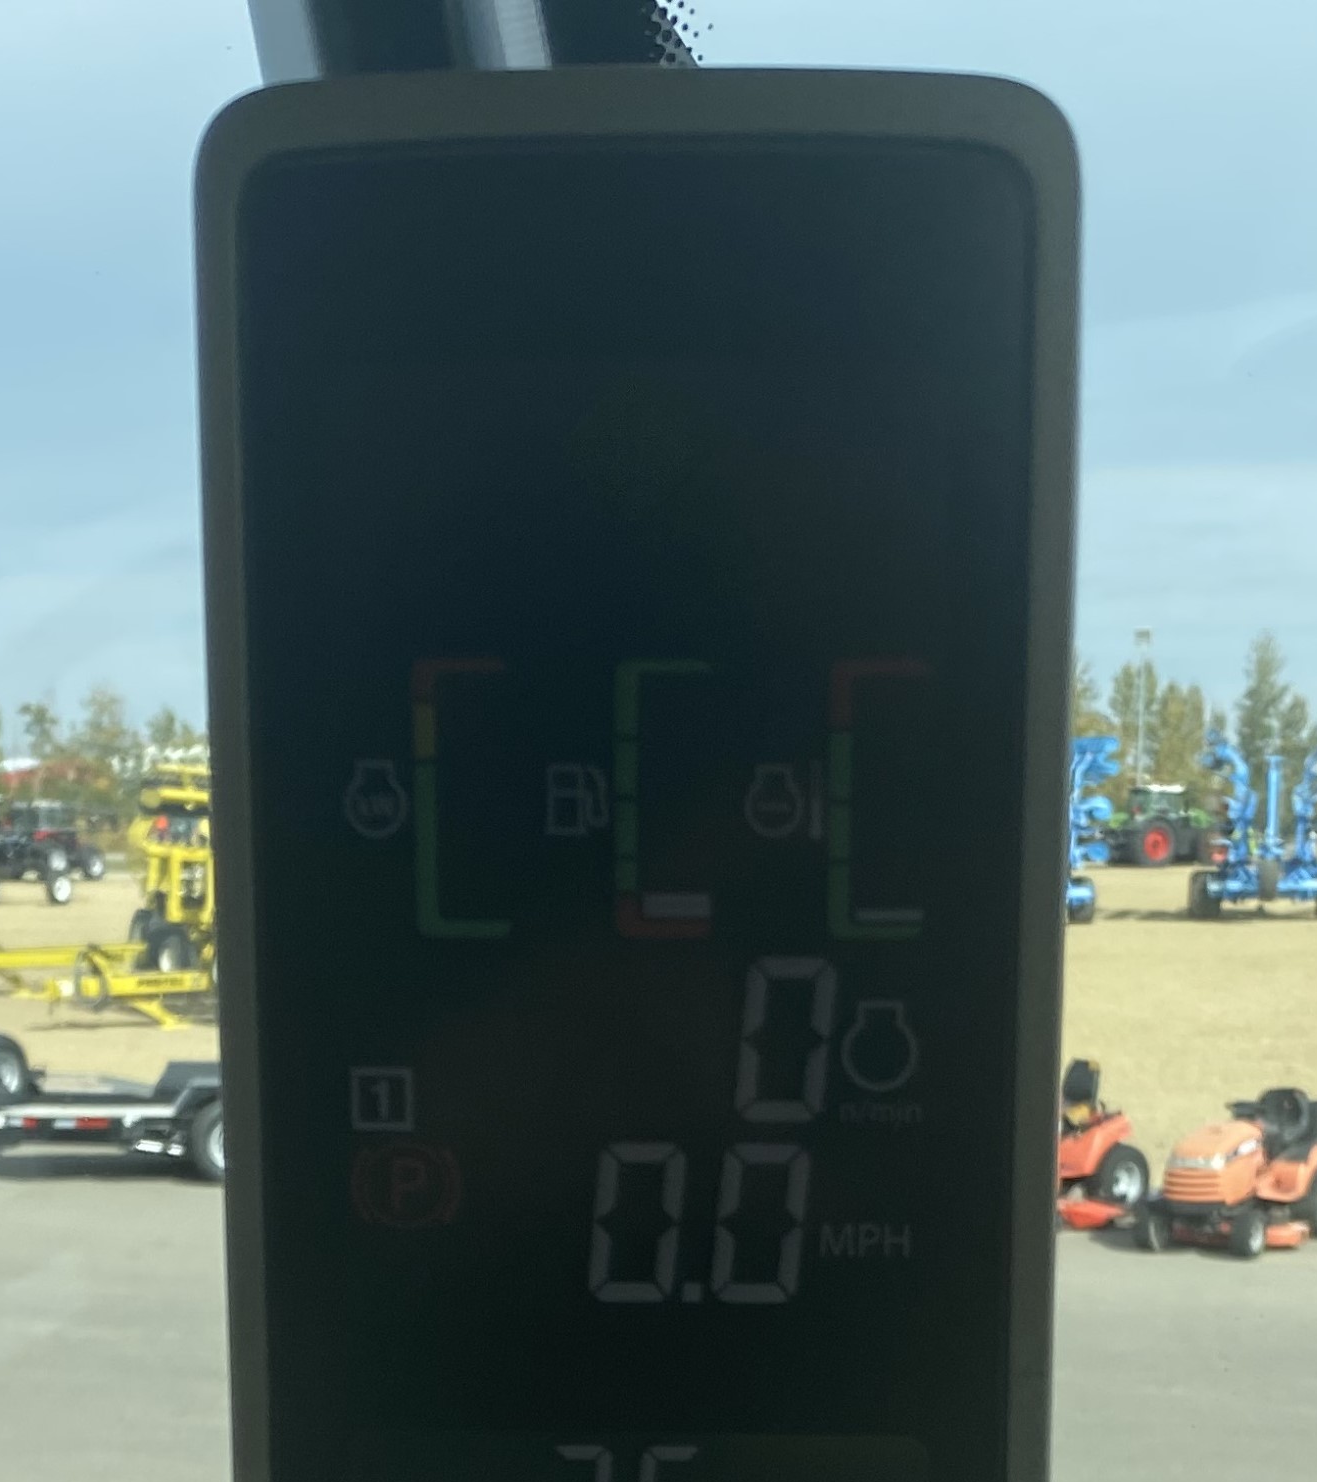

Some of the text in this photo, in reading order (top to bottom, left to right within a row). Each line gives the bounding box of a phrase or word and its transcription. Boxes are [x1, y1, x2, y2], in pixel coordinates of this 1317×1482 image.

[736, 954, 838, 1123] 0
[393, 1156, 427, 1211] P
[588, 1140, 812, 1303] 0.0
[818, 1223, 911, 1260] MPH
